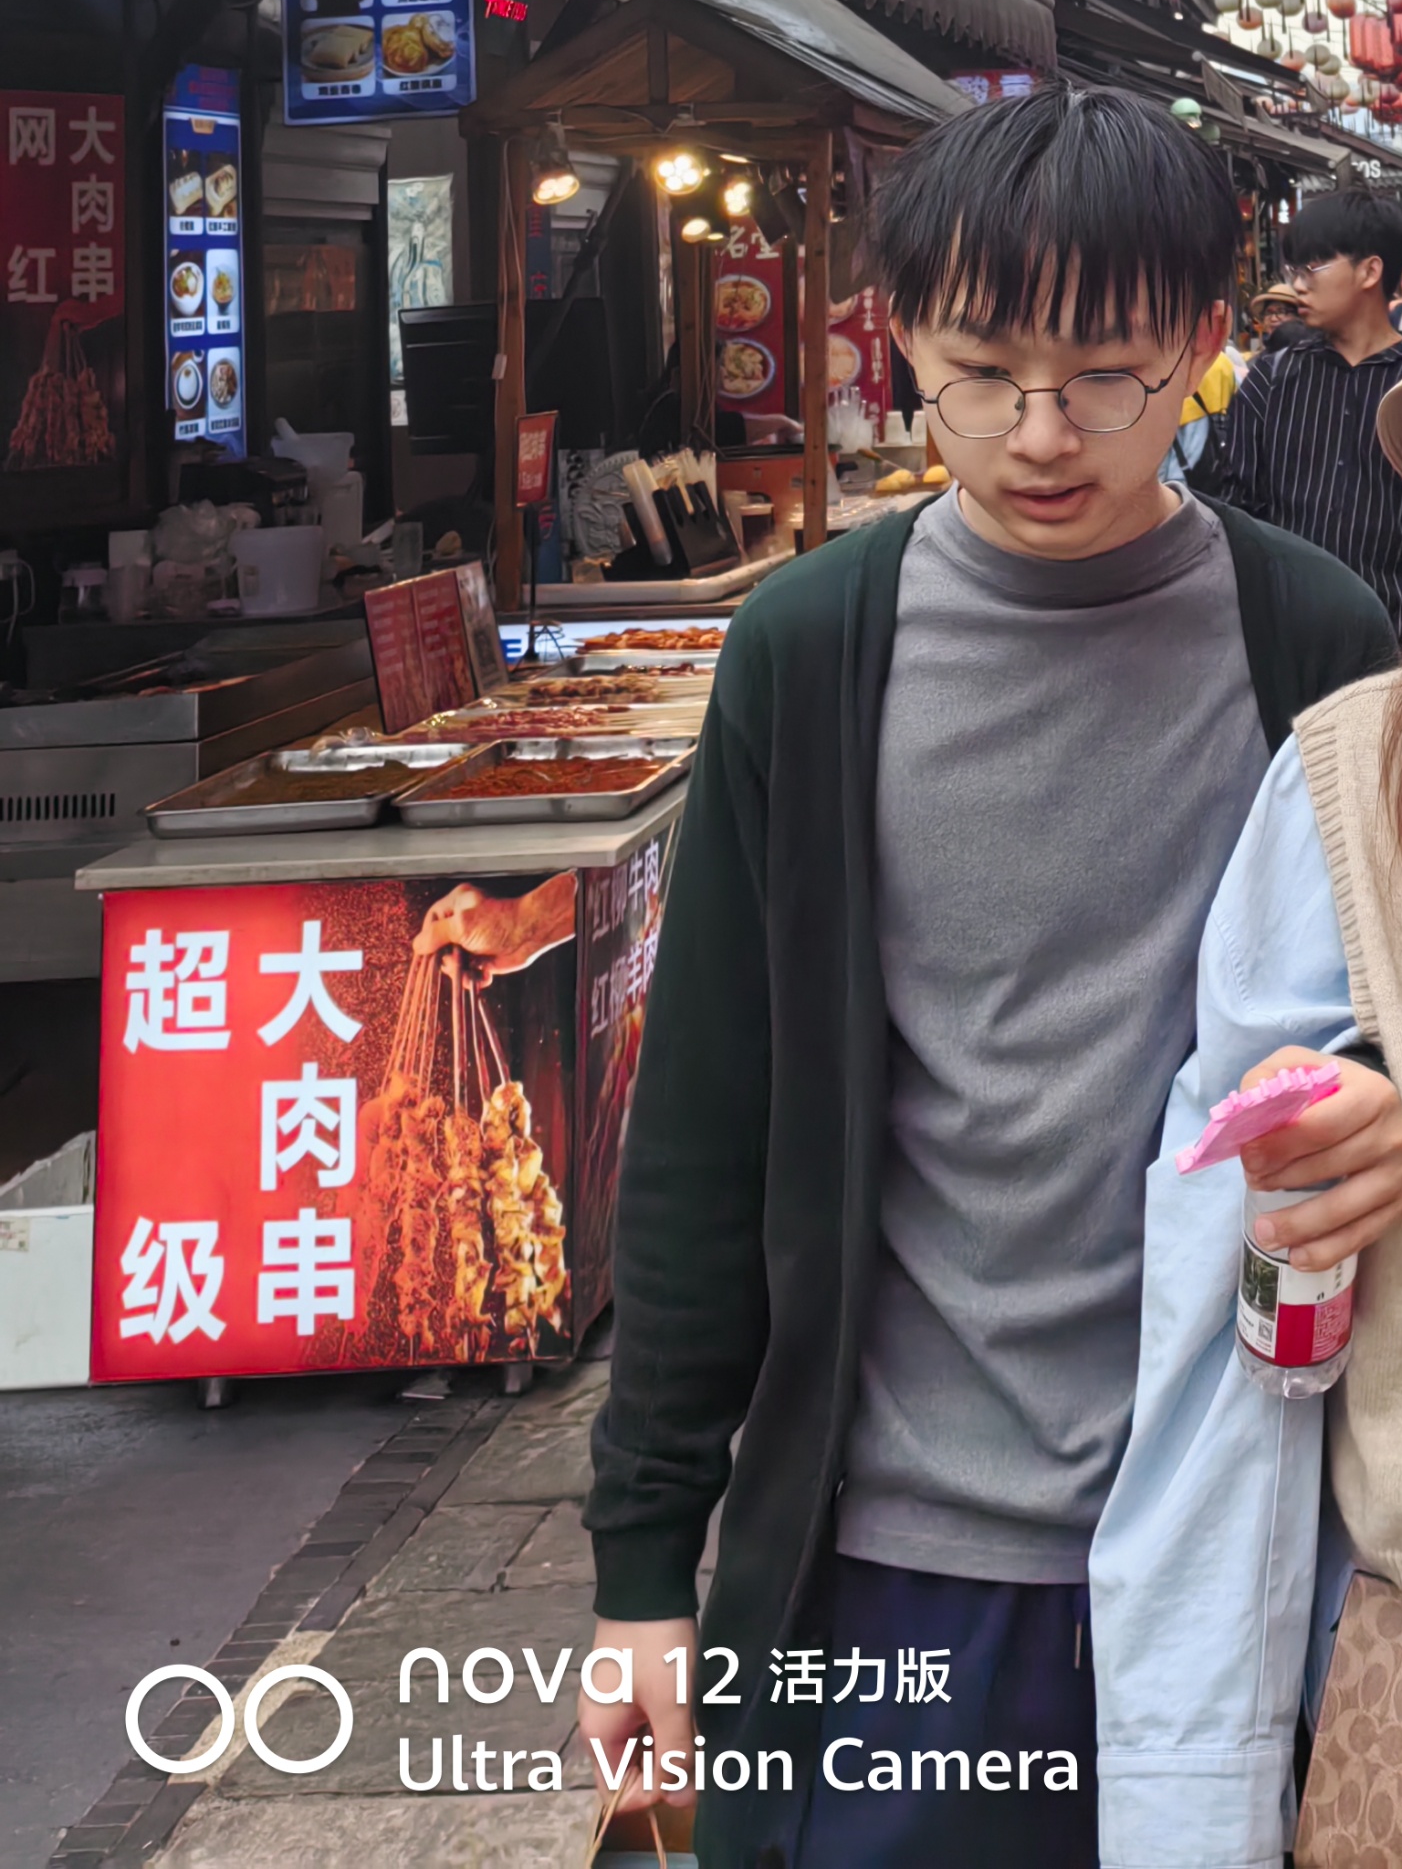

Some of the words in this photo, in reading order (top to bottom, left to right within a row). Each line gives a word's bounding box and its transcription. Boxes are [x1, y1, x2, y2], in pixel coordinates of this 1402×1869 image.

[8, 107, 58, 304] 网红
[68, 105, 117, 303] 大肉串
[119, 928, 232, 1346] 超级
[257, 920, 364, 1337] 大肉串
